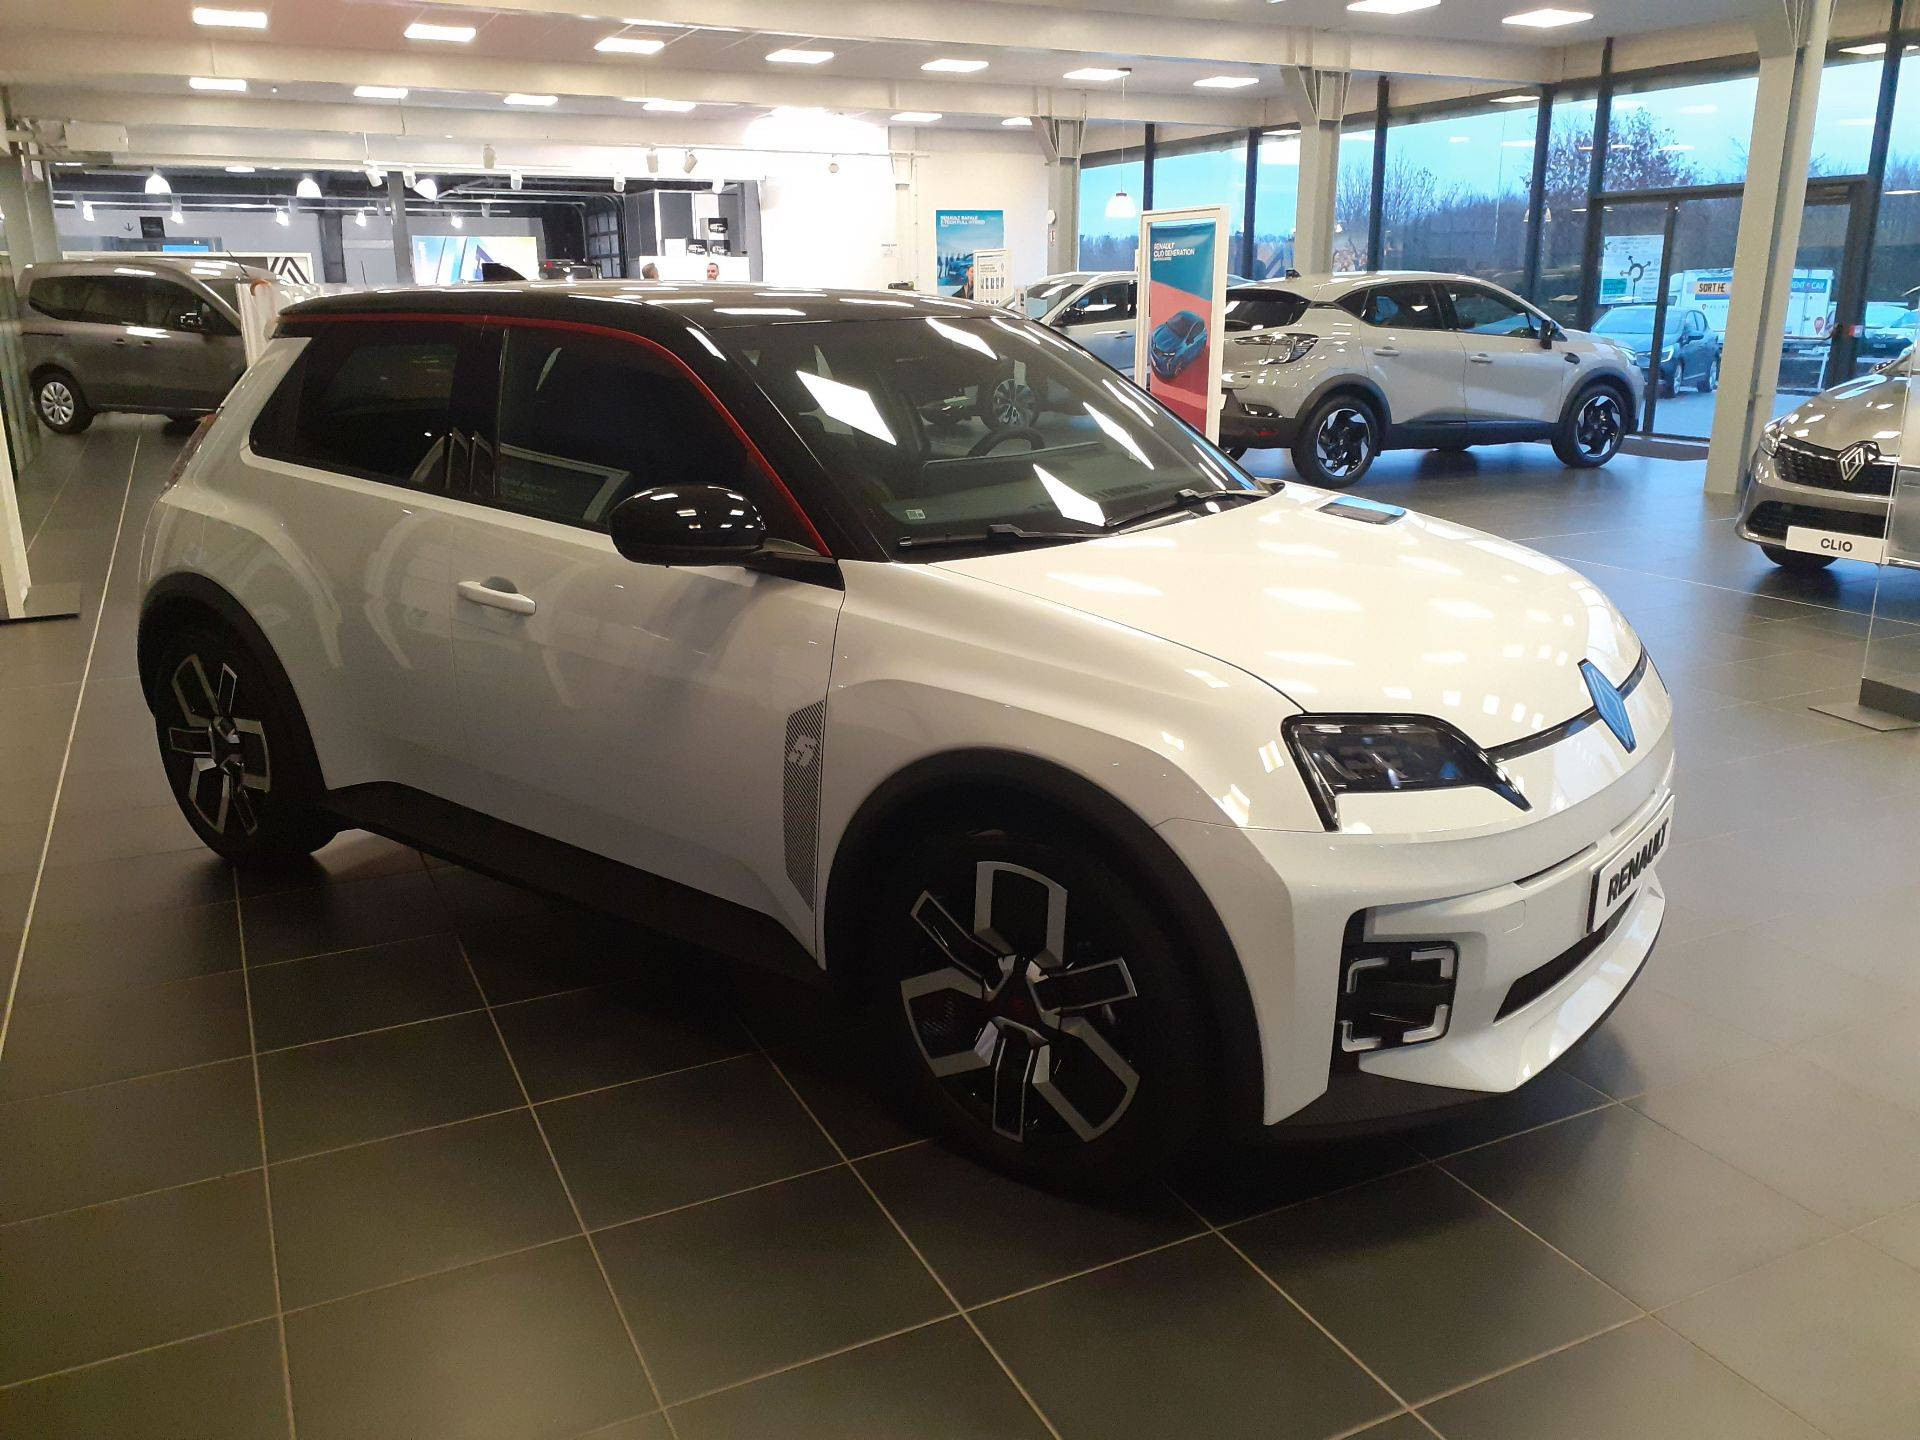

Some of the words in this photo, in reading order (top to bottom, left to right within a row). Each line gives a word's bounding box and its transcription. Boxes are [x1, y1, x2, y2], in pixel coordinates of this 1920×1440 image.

[1154, 242, 1175, 250] RENAULT
[1699, 282, 1726, 293] SORTIE
[1820, 537, 1853, 552] CLIO
[1606, 816, 1670, 907] RENAULT
